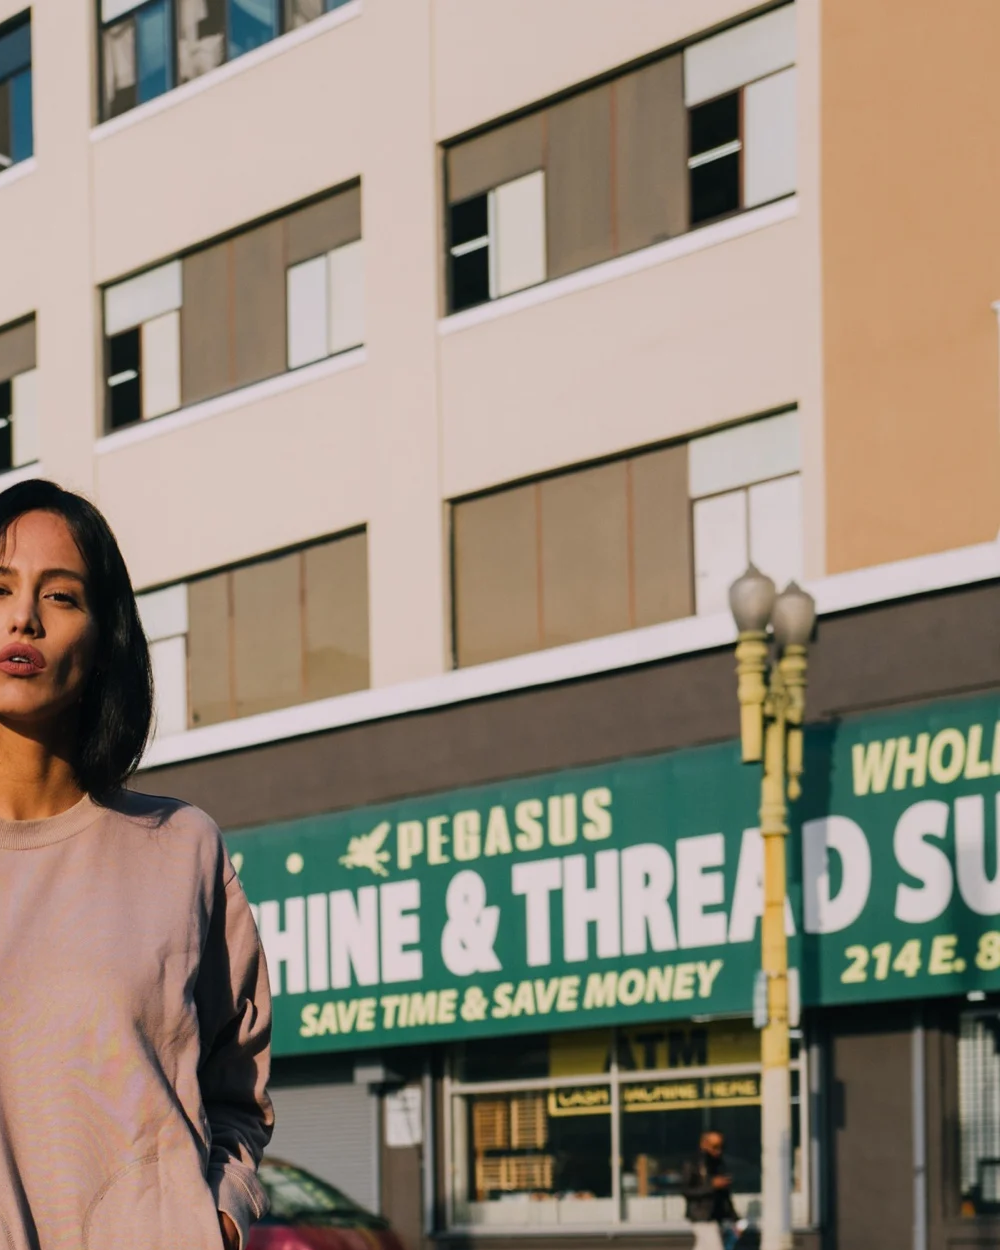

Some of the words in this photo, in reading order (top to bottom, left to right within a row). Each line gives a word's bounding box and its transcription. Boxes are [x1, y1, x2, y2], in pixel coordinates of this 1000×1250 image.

[397, 787, 613, 870] PEGASUS
[249, 878, 423, 997] HINE
[441, 869, 502, 976] &
[511, 814, 872, 967] THREAD
[299, 998, 378, 1038] SAVE
[381, 988, 458, 1029] TIME
[460, 986, 489, 1022] &
[492, 975, 580, 1020] SAVE
[583, 958, 723, 1009] MONEY
[840, 938, 922, 984] 214
[928, 933, 967, 976] E.
